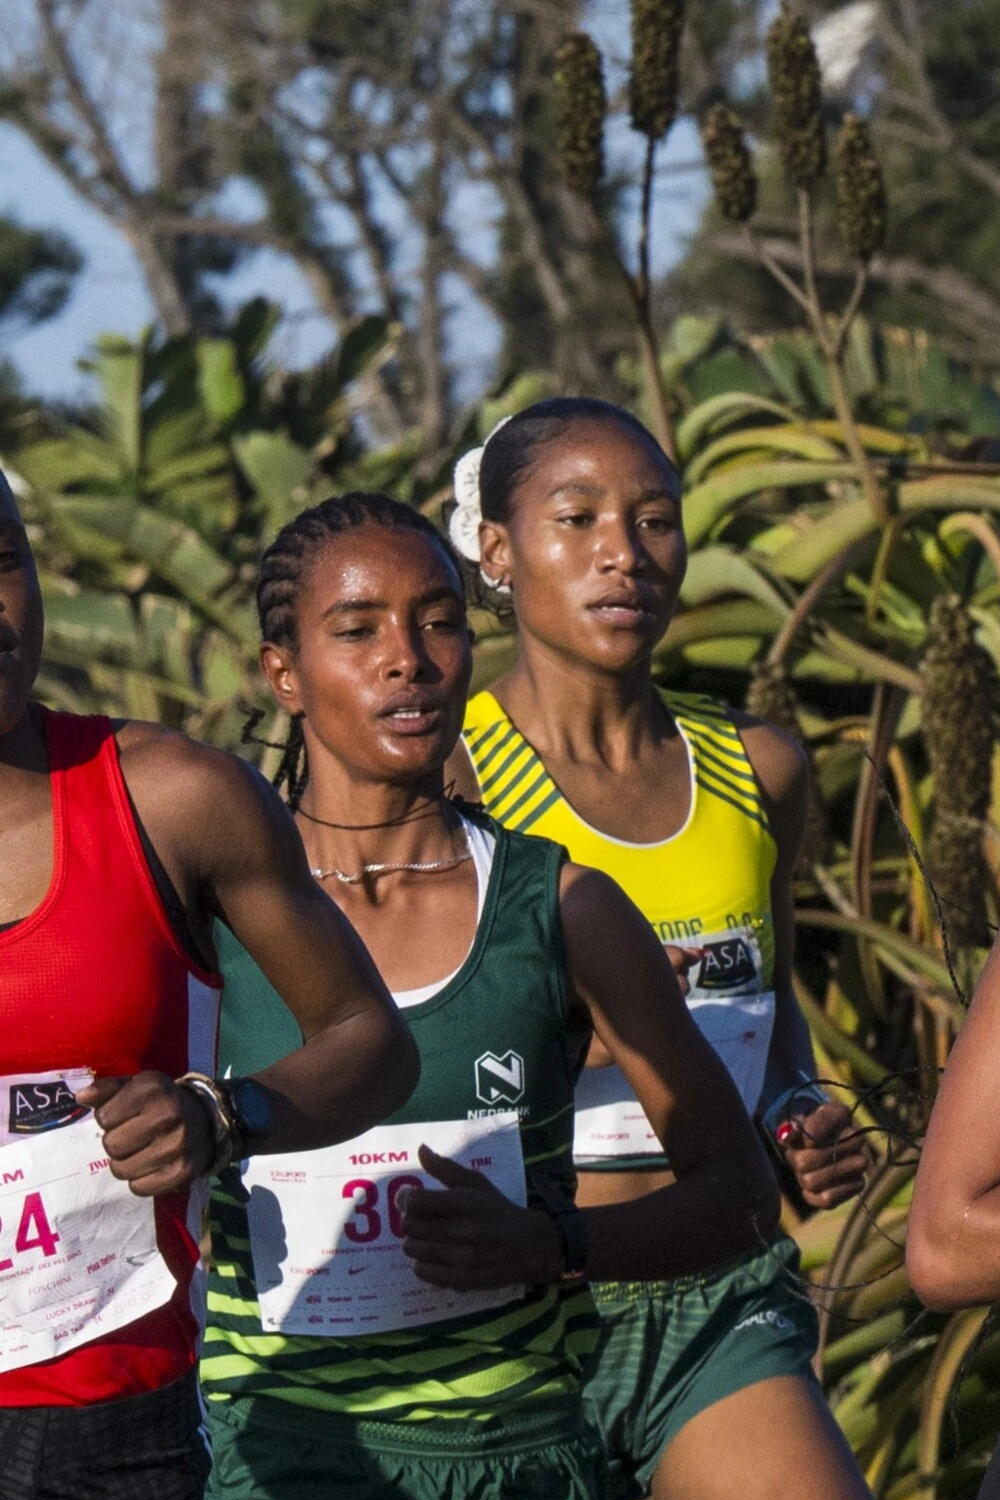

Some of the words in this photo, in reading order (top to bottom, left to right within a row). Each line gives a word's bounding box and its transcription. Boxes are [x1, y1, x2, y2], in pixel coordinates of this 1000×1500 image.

[705, 943, 748, 972] ASA
[16, 1086, 75, 1116] ASA
[349, 1151, 408, 1165] 10KM
[45, 1303, 71, 1321] LUCKY
